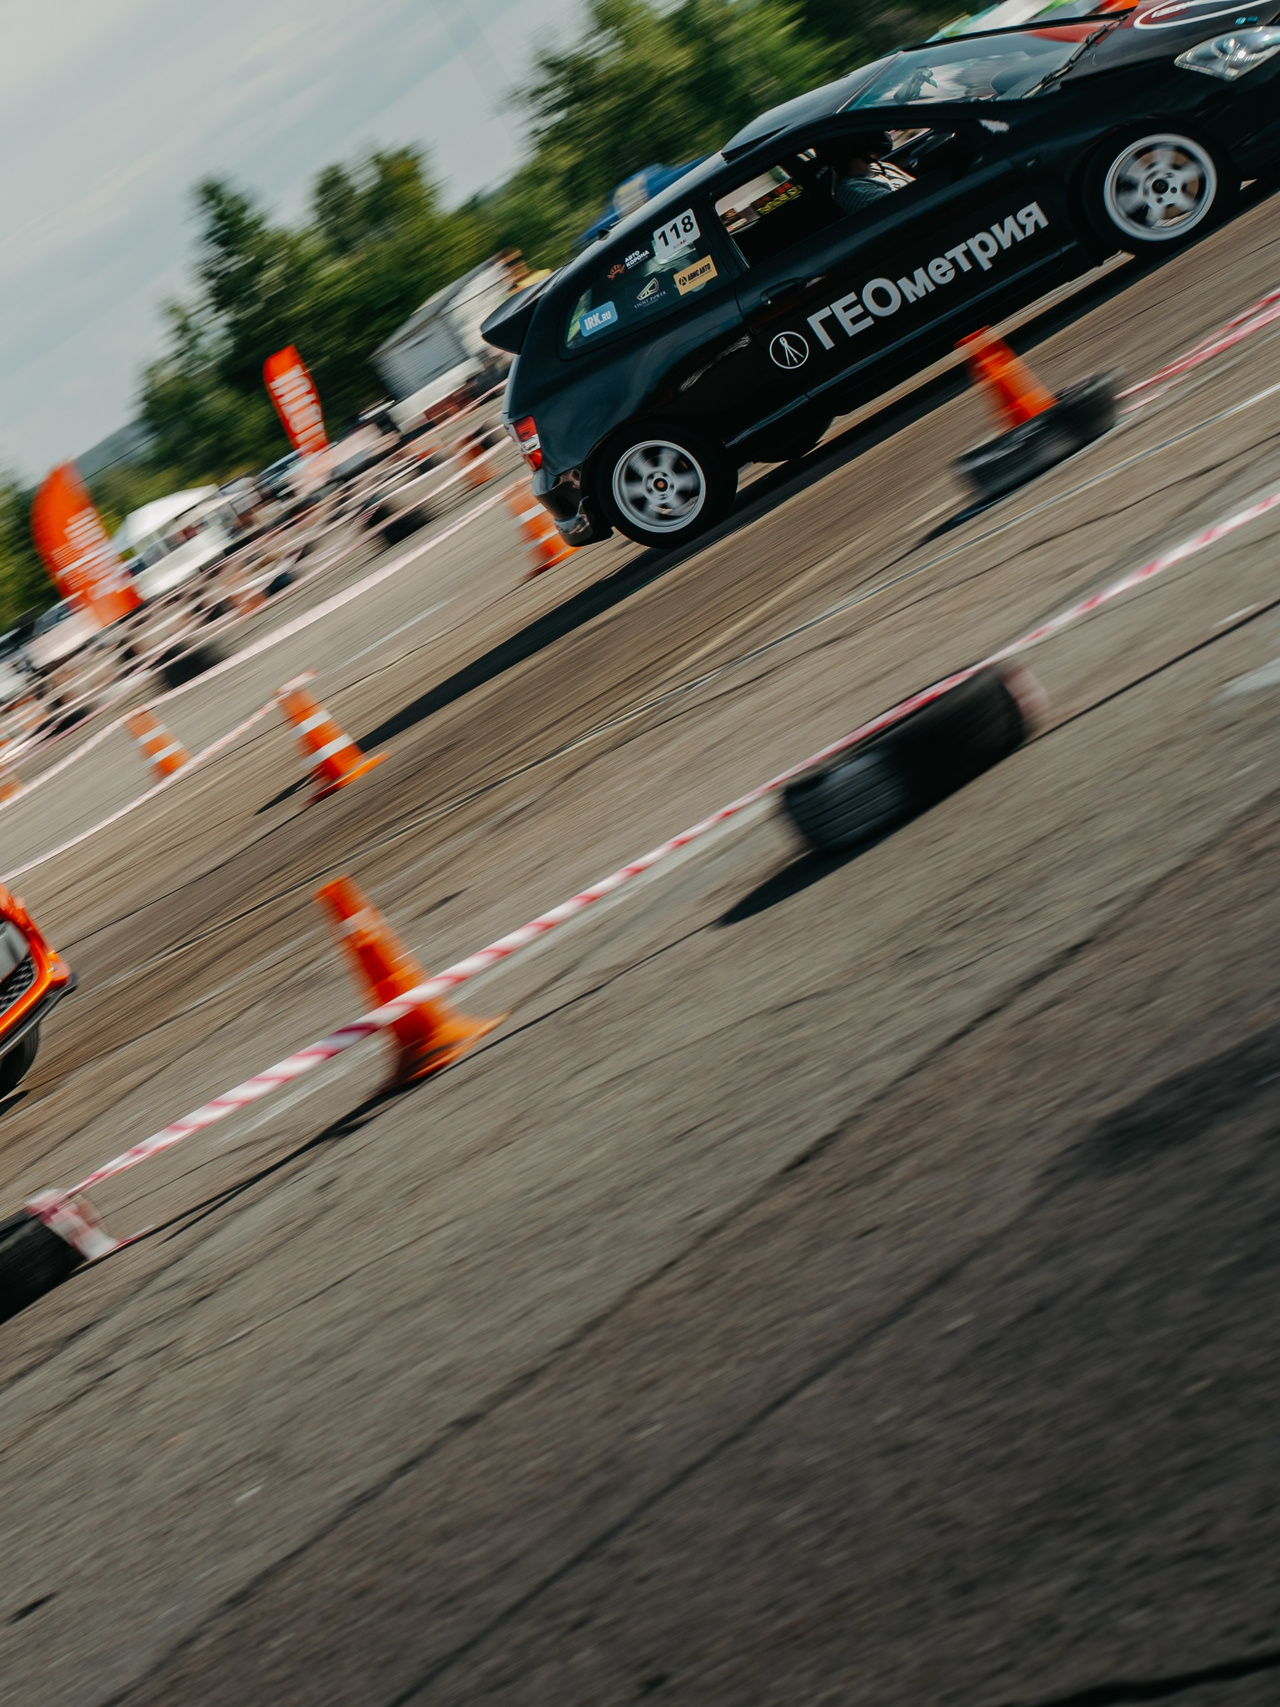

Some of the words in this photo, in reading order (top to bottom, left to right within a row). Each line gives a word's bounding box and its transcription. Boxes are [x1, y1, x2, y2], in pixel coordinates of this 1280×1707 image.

[658, 215, 695, 248] 118
[624, 250, 640, 263] АВТО
[625, 250, 650, 269] КОРОНА
[806, 201, 1050, 350] ГЕОметрия
[584, 310, 612, 331] IRK.RU
